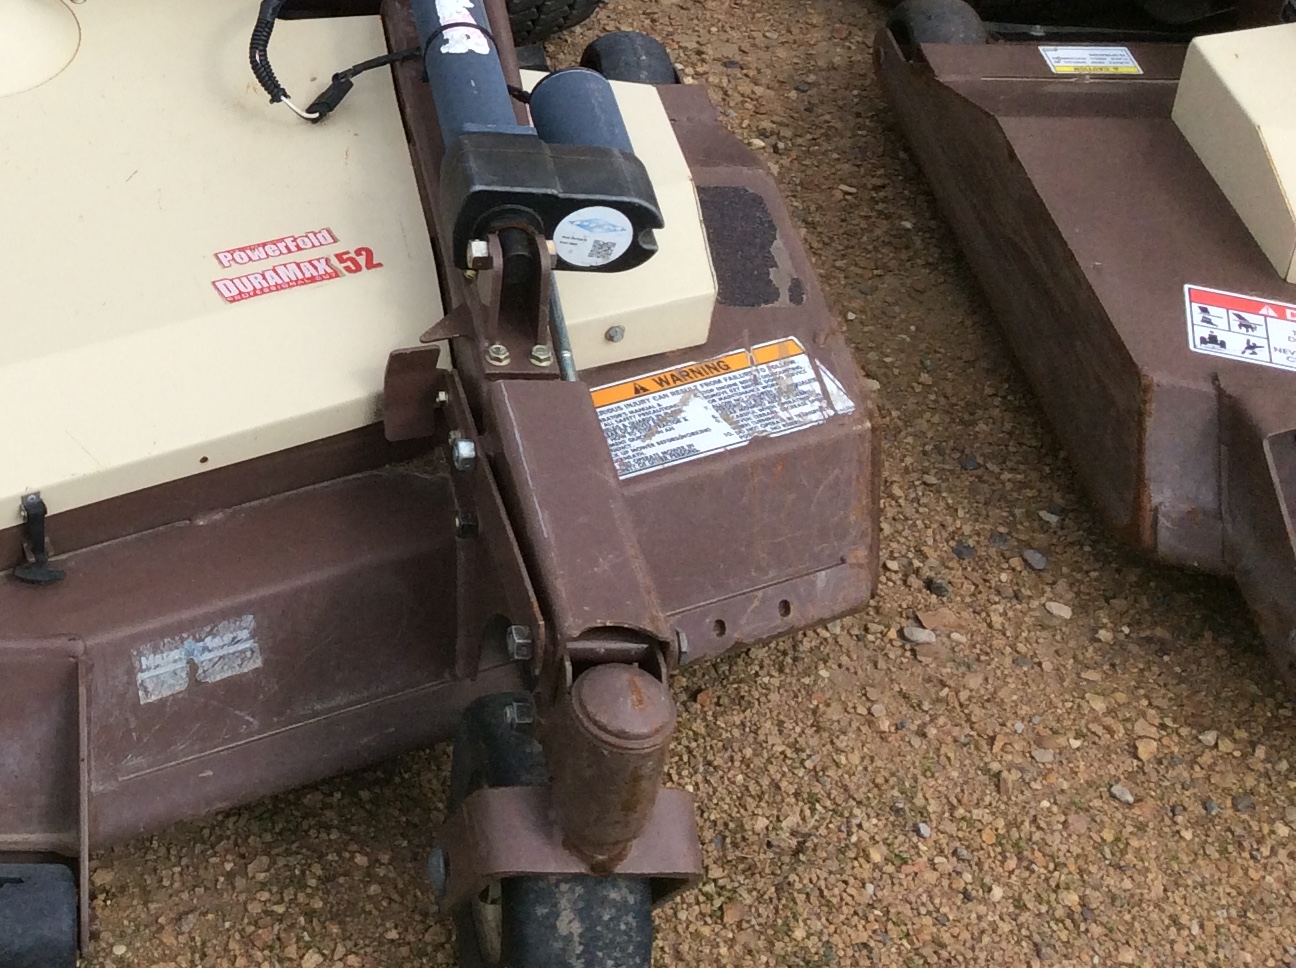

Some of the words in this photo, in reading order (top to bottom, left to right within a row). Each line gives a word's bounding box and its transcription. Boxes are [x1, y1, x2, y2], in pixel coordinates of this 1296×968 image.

[216, 229, 335, 269] PowerFold
[334, 246, 384, 275] 52
[653, 360, 731, 389] WARNING
[597, 404, 623, 416] RIOUS
[624, 397, 650, 409] INJURY
[652, 392, 669, 402] CAN
[699, 378, 722, 389] FROM
